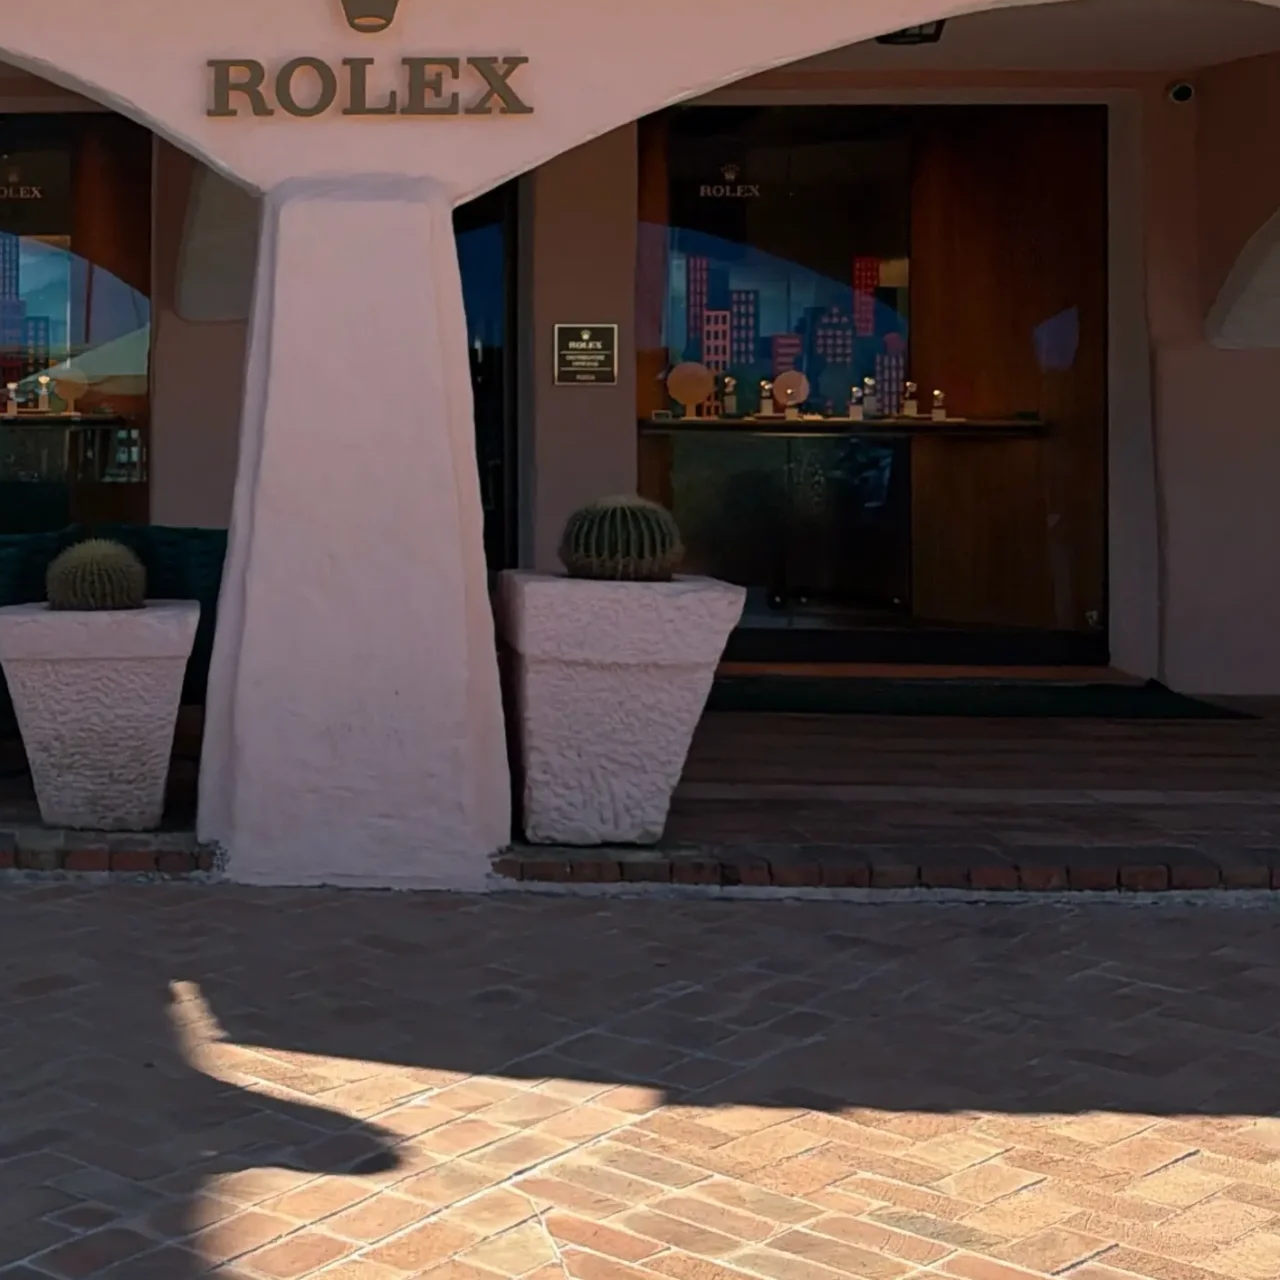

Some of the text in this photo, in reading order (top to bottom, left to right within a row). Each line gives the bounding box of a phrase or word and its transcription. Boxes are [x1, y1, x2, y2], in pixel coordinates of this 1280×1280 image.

[206, 56, 534, 117] ROLEX
[699, 184, 760, 197] ROLEX
[568, 341, 603, 349] ROLEX
